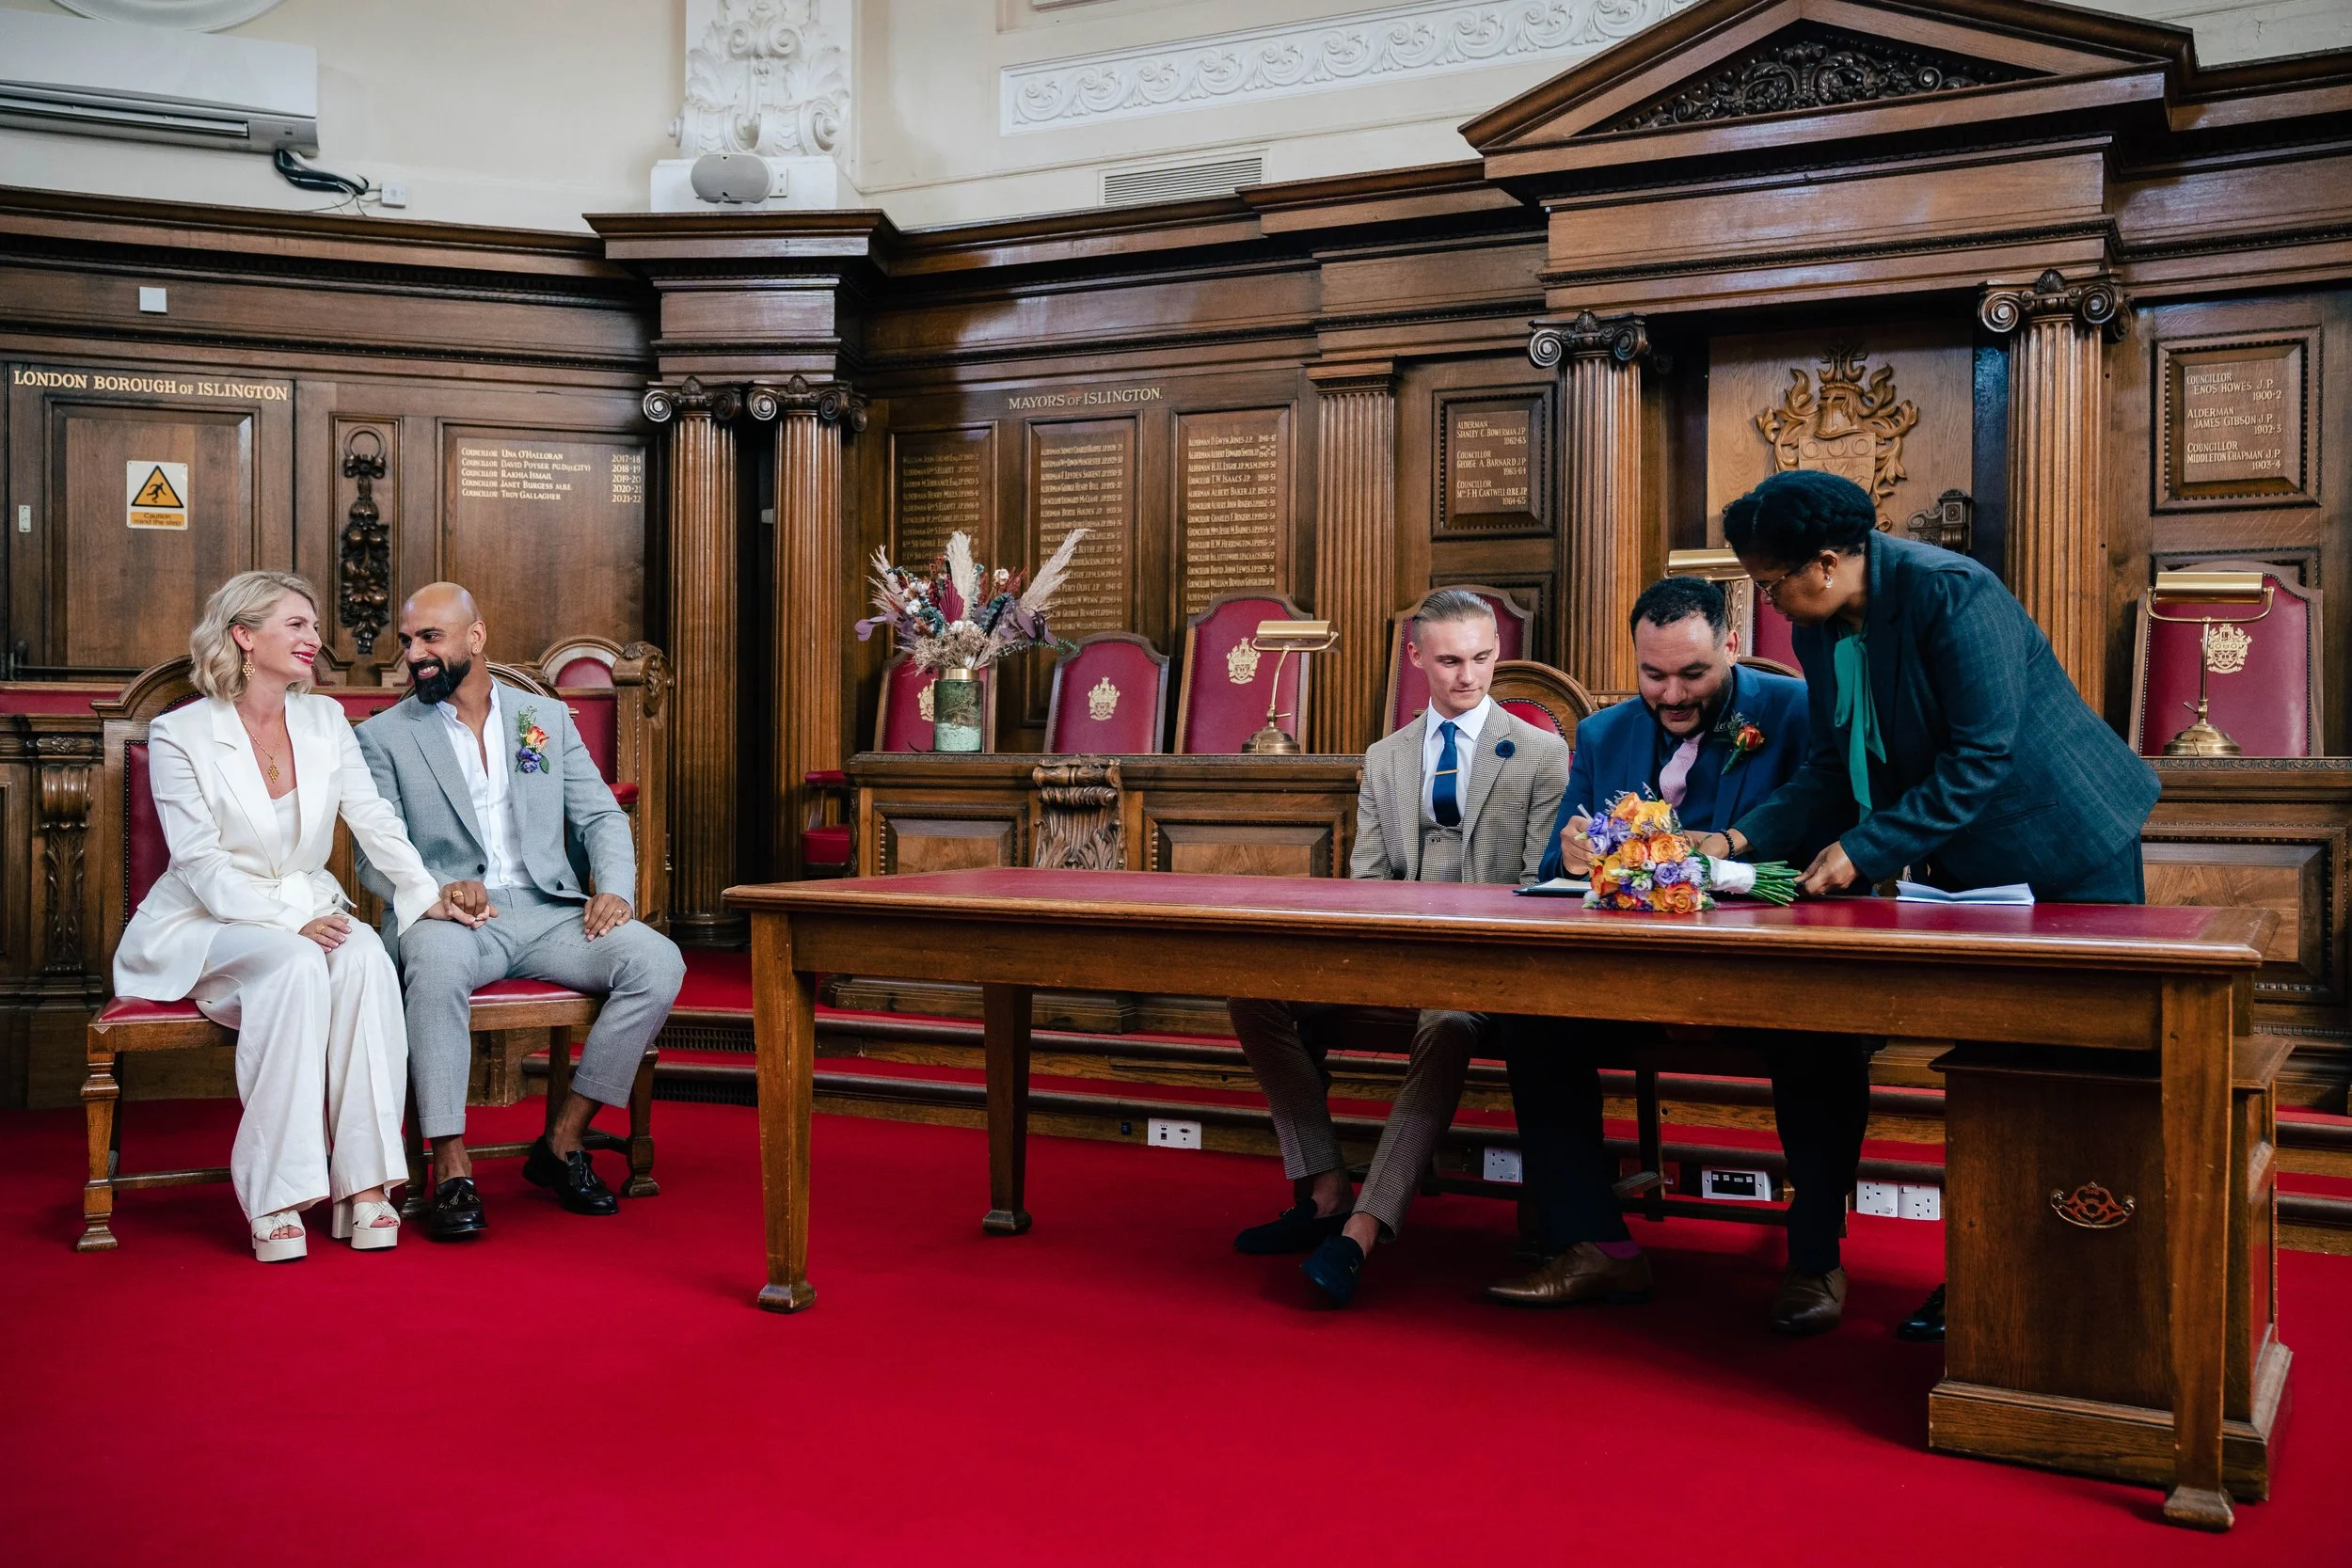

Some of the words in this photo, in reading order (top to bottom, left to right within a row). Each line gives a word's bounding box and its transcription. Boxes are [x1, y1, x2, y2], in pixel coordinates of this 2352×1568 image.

[2186, 372, 2233, 385] COUNCILLOR
[13, 370, 87, 389] LONDON
[93, 376, 177, 395] BOROUGH
[197, 382, 288, 402] ISLINGTON
[2194, 384, 2217, 395] ENOS
[2220, 382, 2252, 393] HOWES
[2252, 389, 2281, 402] 1900-2
[1009, 395, 1065, 410] MAYORS
[2186, 406, 2234, 420] ALDERMAN
[1456, 420, 1488, 430] ALDERMAN
[2193, 418, 2220, 430] JAMES
[2223, 415, 2256, 426] GIBSON
[1456, 429, 1479, 438] STANLEY
[1486, 427, 1517, 437] BOWERMAN
[1230, 436, 1245, 444] JONES
[1503, 436, 1527, 445] 1962-63
[2186, 440, 2238, 453] COUNCILLOR
[461, 448, 499, 457] COUNCILLOR
[501, 449, 517, 459] UNA
[517, 450, 564, 460] O'HALLORAN
[612, 454, 641, 464] 2017-18
[1456, 450, 1492, 459] COUNCILLOR
[2186, 452, 2227, 464] MIDDLETON
[2228, 449, 2263, 461] CHAPMAN
[461, 457, 499, 467] COUNCILLOR
[501, 459, 522, 468] DAVID
[523, 460, 549, 470] POYSER
[612, 464, 641, 473] 2018-19
[1456, 459, 1476, 468] GEORGE
[1486, 458, 1517, 467] BARNARD
[2252, 460, 2281, 470] 1903-4
[461, 467, 499, 478] COUNCILLOR
[501, 469, 529, 479] RAKHIA
[529, 471, 552, 480] ISMAIL
[612, 474, 642, 483] 2019-20
[1503, 467, 1527, 476] 1963-64
[1222, 474, 1242, 483] ISAACS
[1456, 480, 1492, 489] COUNCILLOR
[461, 478, 499, 487] COUNCILLOR
[501, 480, 521, 488] JANET
[522, 481, 553, 490] BURGESS
[612, 484, 642, 494] 2020-21
[1211, 488, 1230, 497] ALBERT
[1230, 486, 1248, 496] BAKER
[461, 488, 499, 498] COUNCILLOR
[501, 489, 518, 499] TROY
[519, 491, 562, 500] GALLAGHER
[612, 494, 642, 503] 2021-22
[1478, 488, 1505, 498] CANTWELL
[1502, 497, 1526, 505] 1964-65
